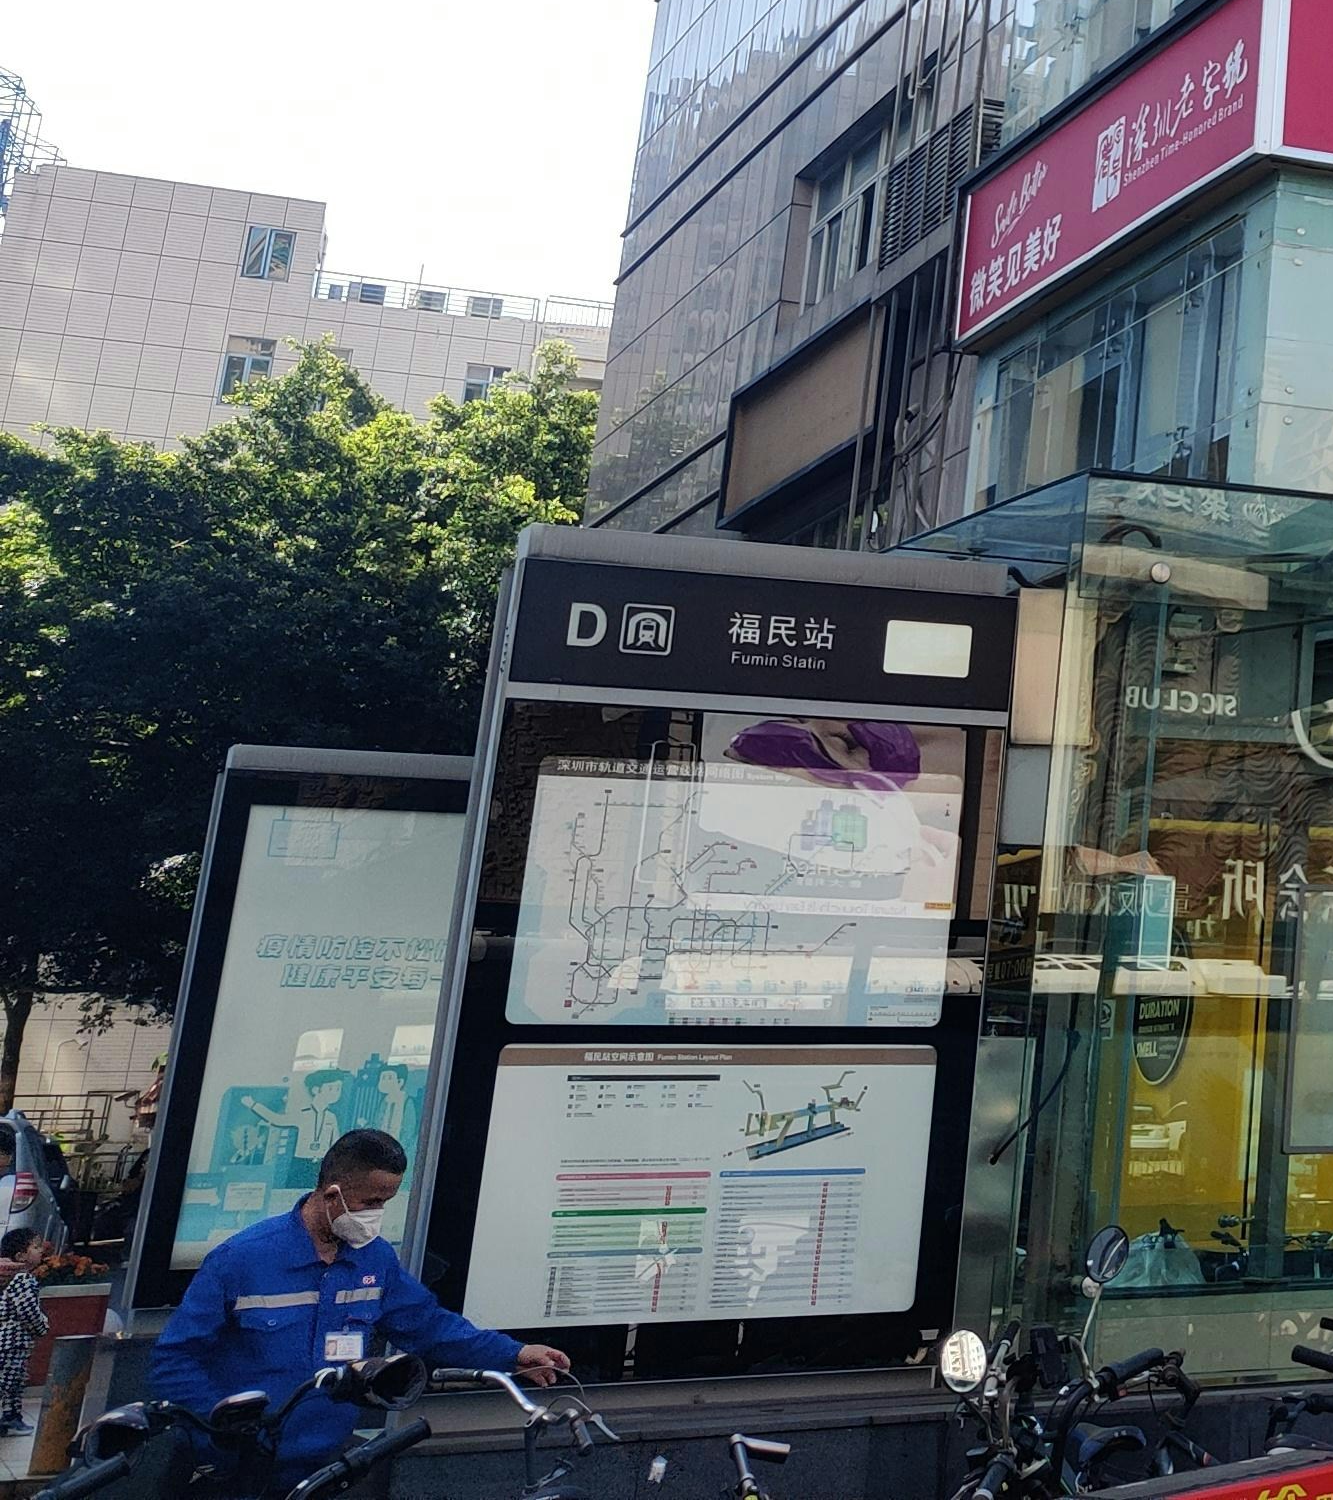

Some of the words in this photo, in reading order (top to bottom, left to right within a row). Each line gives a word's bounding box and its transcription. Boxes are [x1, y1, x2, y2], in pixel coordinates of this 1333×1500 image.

[1123, 155, 1159, 187] Shenzhen
[1159, 114, 1218, 162] Time-Honored
[1218, 95, 1245, 127] Brand
[969, 214, 1062, 317] 微笑见美好
[566, 603, 607, 648] D
[728, 611, 837, 650] 福民站
[731, 651, 778, 668] Fumin
